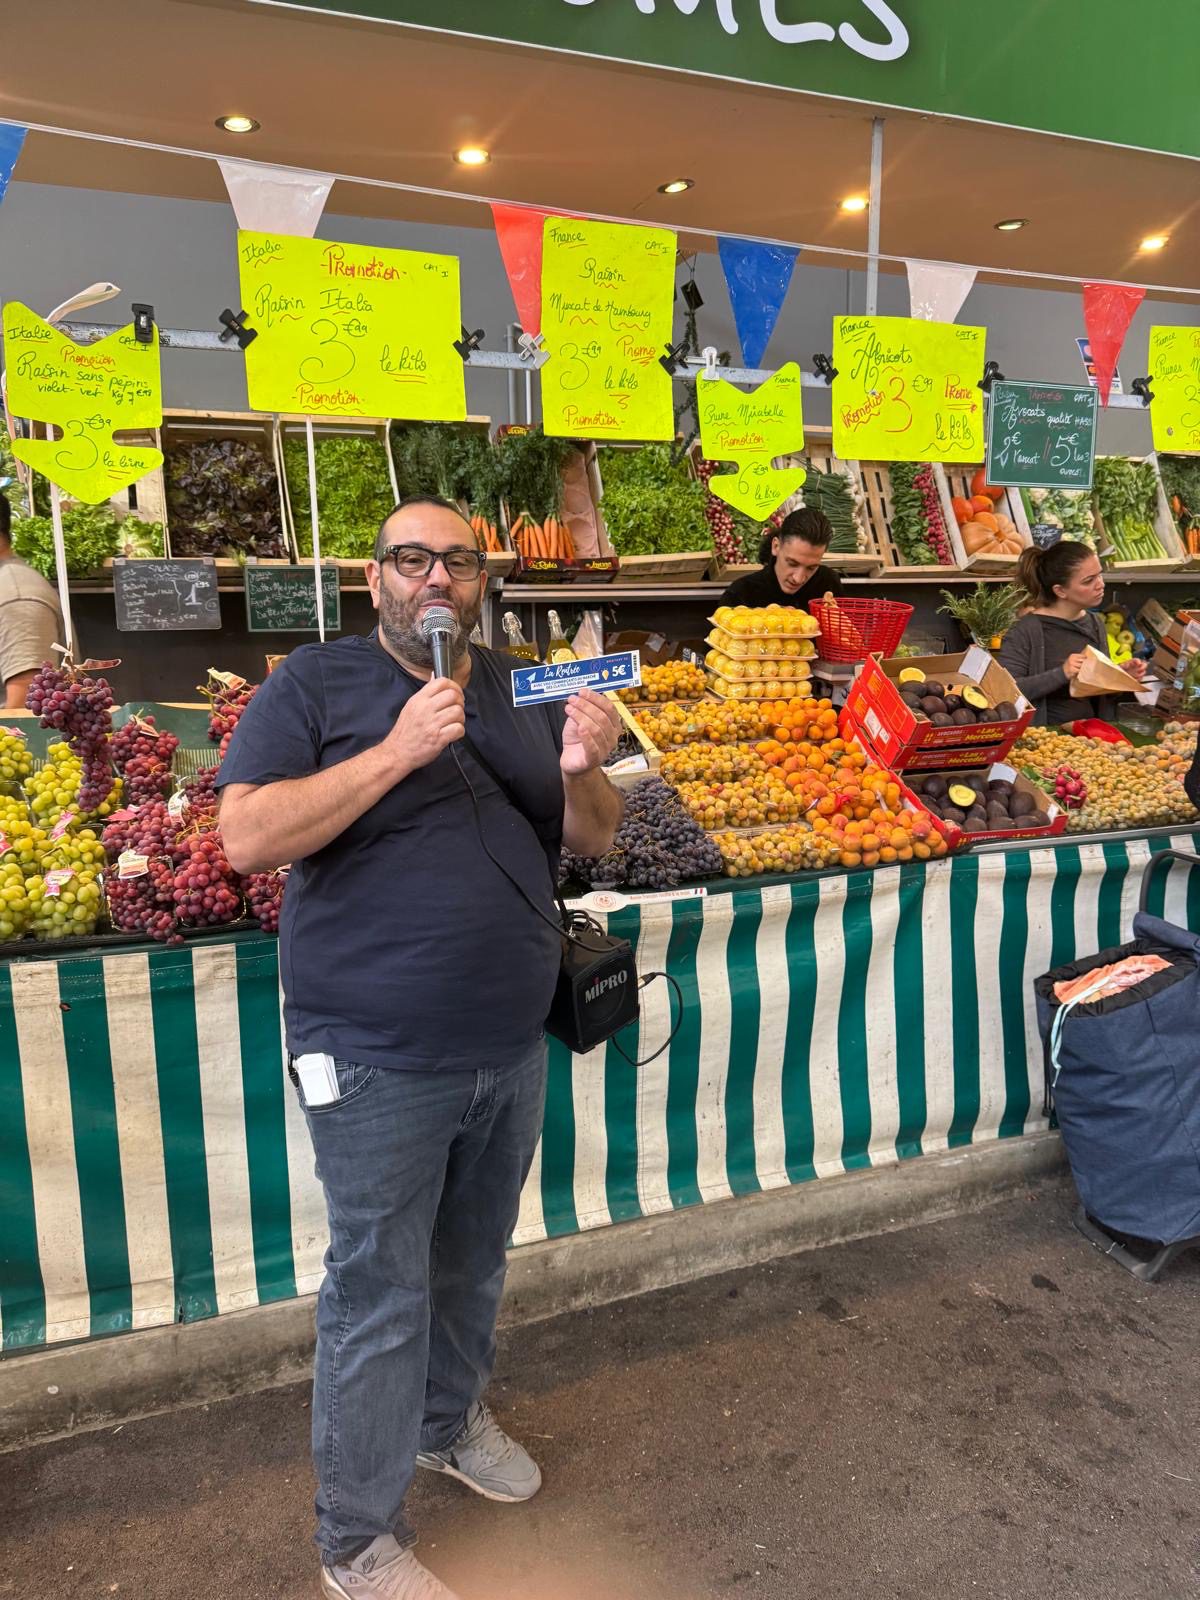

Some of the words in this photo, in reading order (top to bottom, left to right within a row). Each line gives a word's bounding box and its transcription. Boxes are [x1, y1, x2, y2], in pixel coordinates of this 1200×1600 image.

[549, 227, 586, 243] France
[320, 288, 374, 313] Italia
[8, 325, 54, 340] Italie
[839, 317, 875, 339] France
[77, 371, 104, 383] sans
[612, 664, 627, 677] 5€
